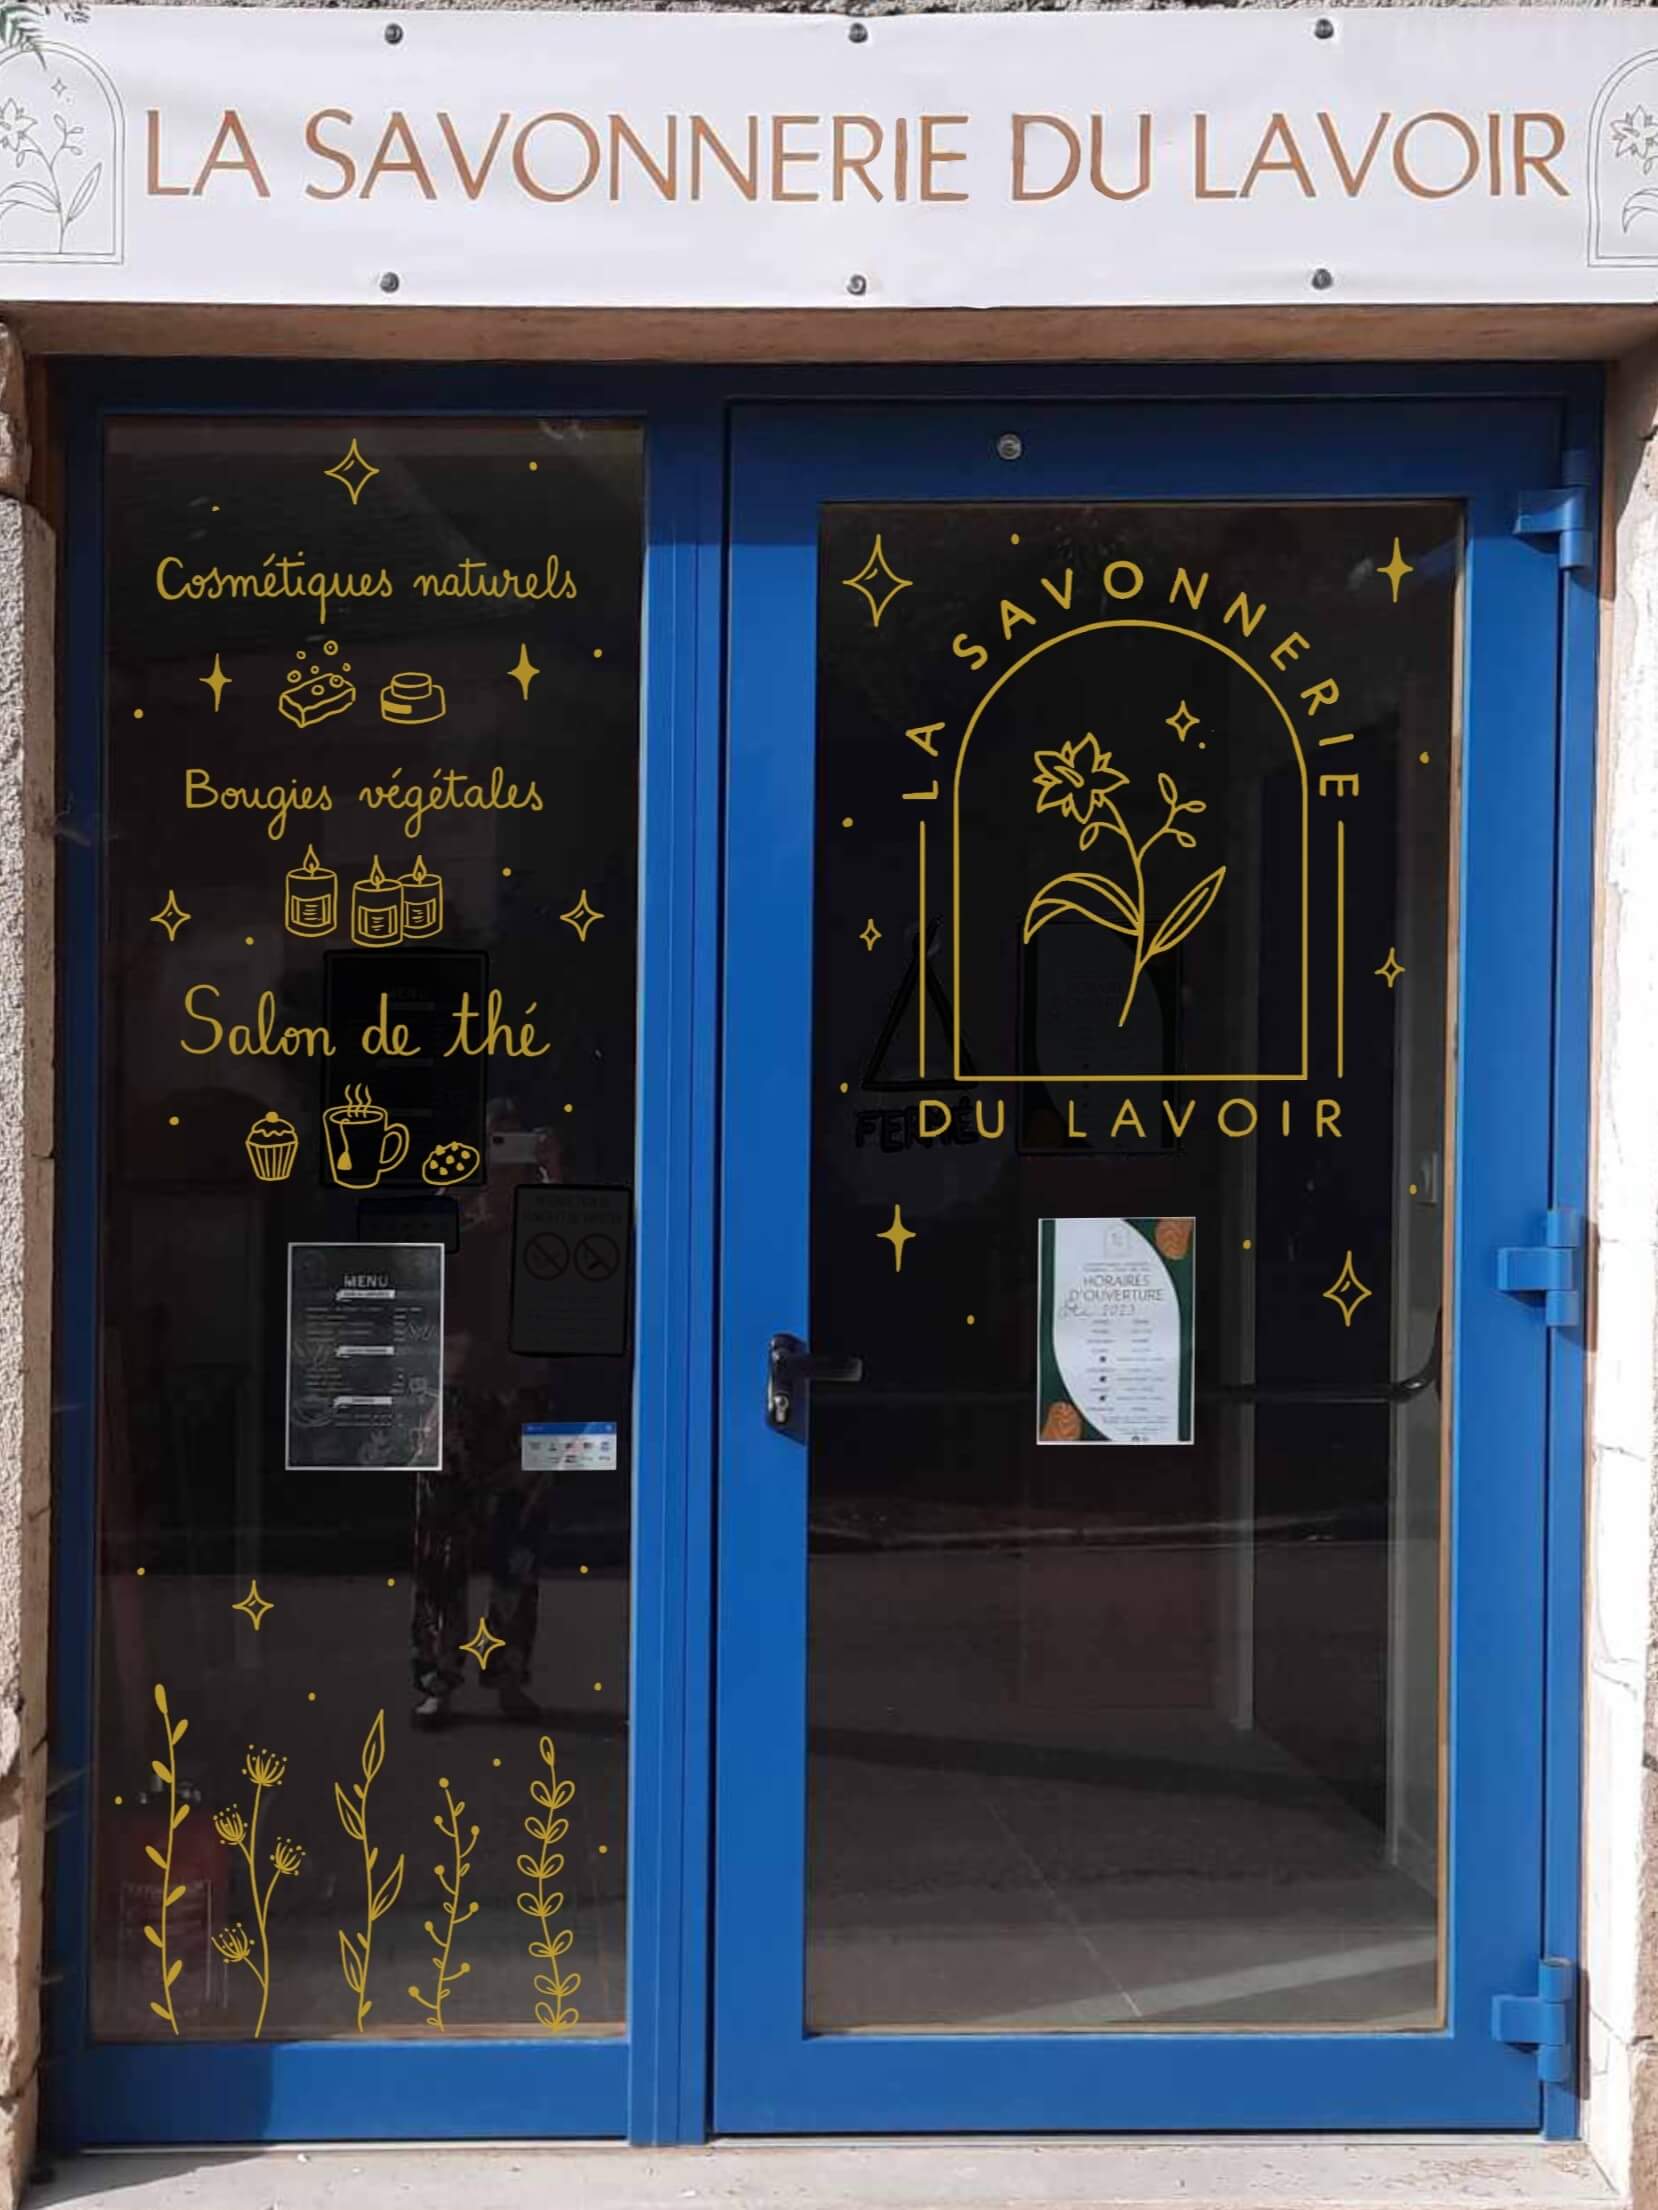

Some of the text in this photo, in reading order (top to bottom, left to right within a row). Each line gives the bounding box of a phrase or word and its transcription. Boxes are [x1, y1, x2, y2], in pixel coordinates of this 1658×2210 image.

[150, 109, 1571, 203] LA SAVONNERIE DU LAVOIR
[156, 551, 577, 624] Cosmétiques naturels
[902, 559, 1360, 801] LA SAVONNERIE
[185, 767, 544, 841] Bougies végétales
[180, 984, 551, 1057] Salon de thé
[918, 1098, 1343, 1139] DU LAVOIR
[343, 1274, 389, 1288] MENU
[1069, 1289, 1163, 1302] D'OUVERTURE
[1083, 1274, 1150, 1287] HORAIRES
